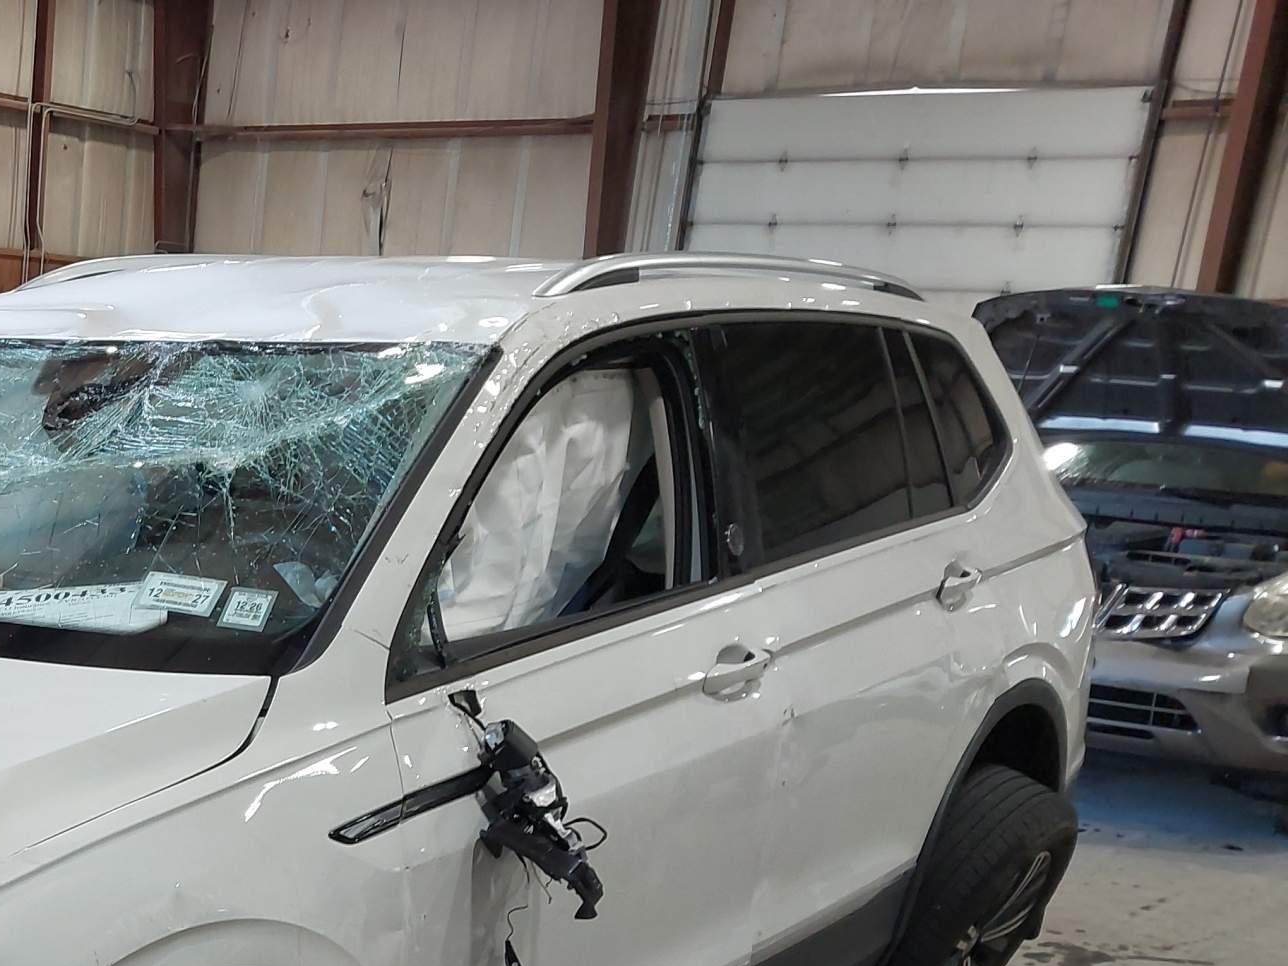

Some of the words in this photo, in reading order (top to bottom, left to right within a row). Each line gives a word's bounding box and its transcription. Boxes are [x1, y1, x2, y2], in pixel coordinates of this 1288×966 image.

[148, 587, 164, 598] 12
[191, 593, 210, 605] 27
[235, 600, 247, 611] 12
